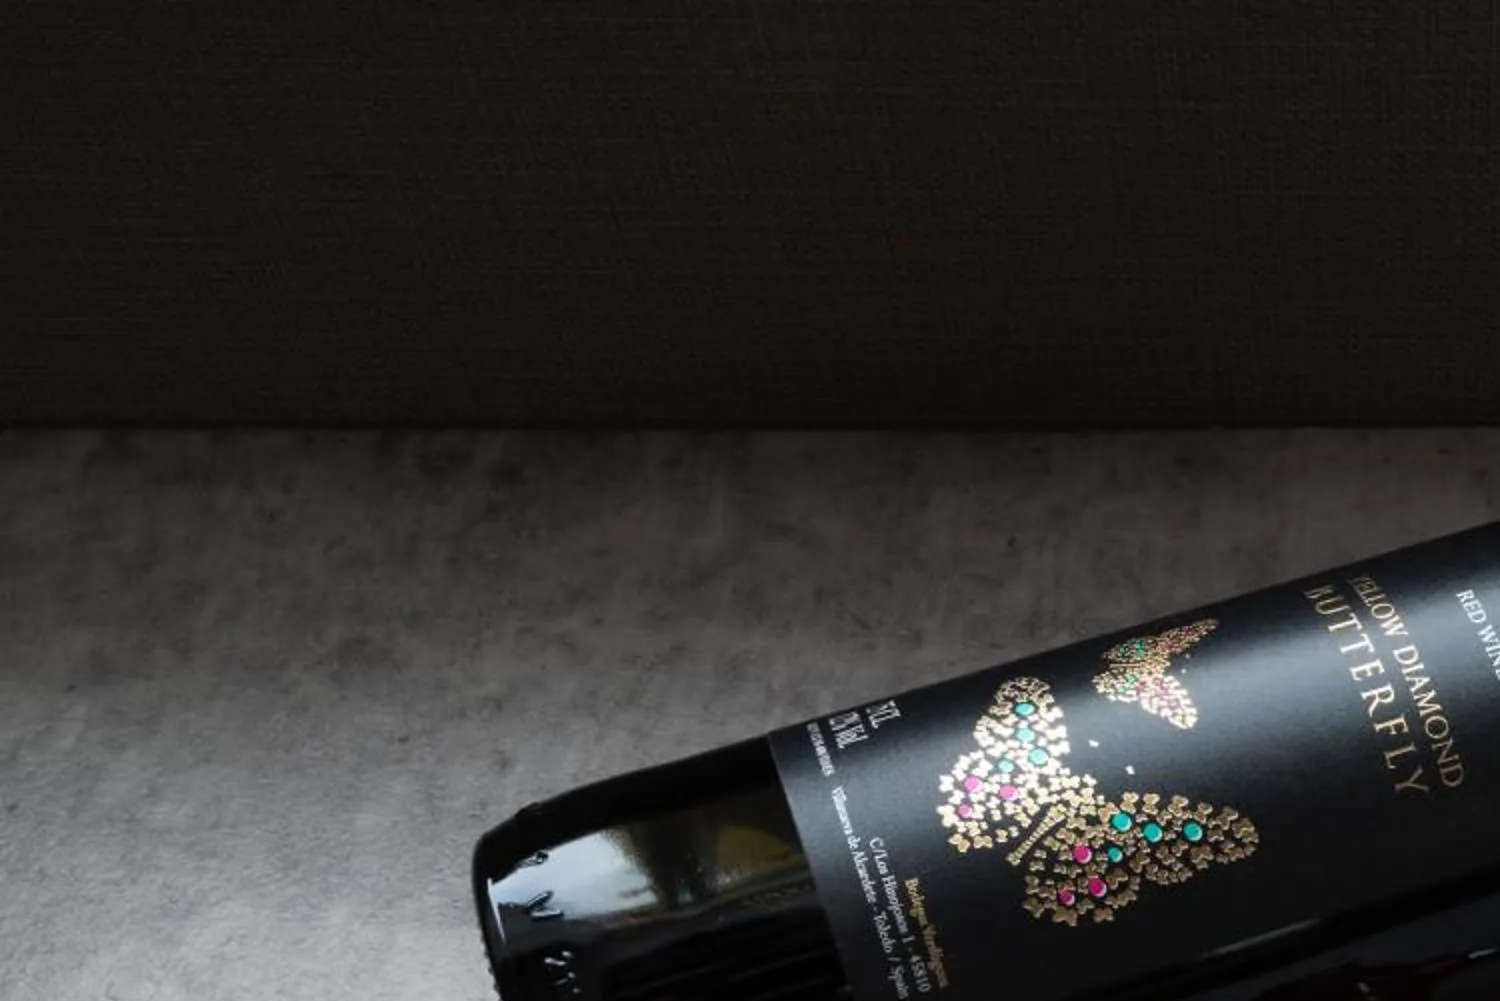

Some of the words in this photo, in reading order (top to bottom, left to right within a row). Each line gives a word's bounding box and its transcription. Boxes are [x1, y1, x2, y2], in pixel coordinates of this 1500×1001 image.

[1456, 589, 1487, 624] RED
[1304, 585, 1430, 793] BUTTERFLY
[1347, 573, 1409, 638] YELLOW
[1393, 645, 1466, 788] DIAMOND
[873, 911, 897, 954] Toledo
